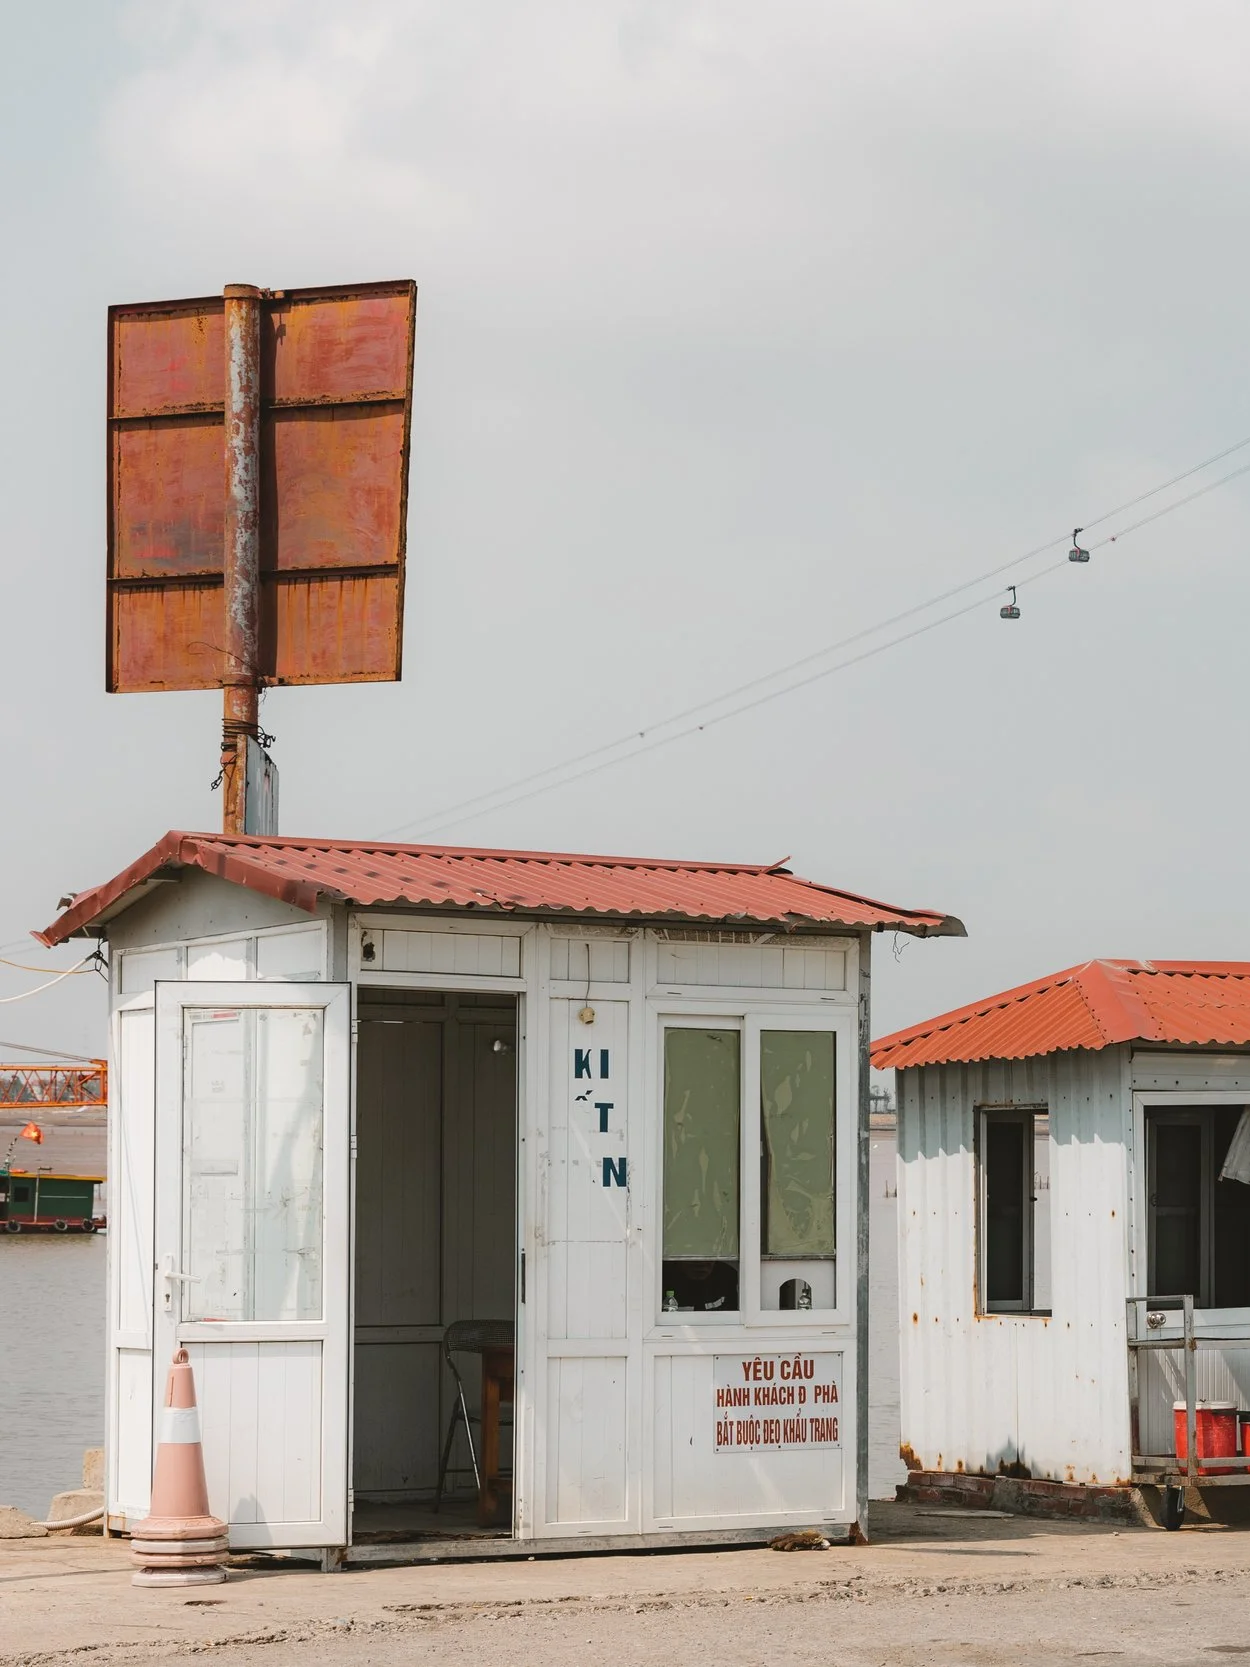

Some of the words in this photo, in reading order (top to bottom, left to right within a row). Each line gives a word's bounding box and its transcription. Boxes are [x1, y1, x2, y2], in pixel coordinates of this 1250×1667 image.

[742, 1356, 774, 1381] YÊU
[780, 1352, 814, 1380] CẦU
[716, 1384, 750, 1407] HÀNH
[754, 1382, 795, 1406] KHÁCH
[814, 1380, 838, 1403] PHÀ
[716, 1411, 734, 1445] BẮT
[763, 1418, 780, 1444] ĐEO
[809, 1417, 838, 1442] TRANG
